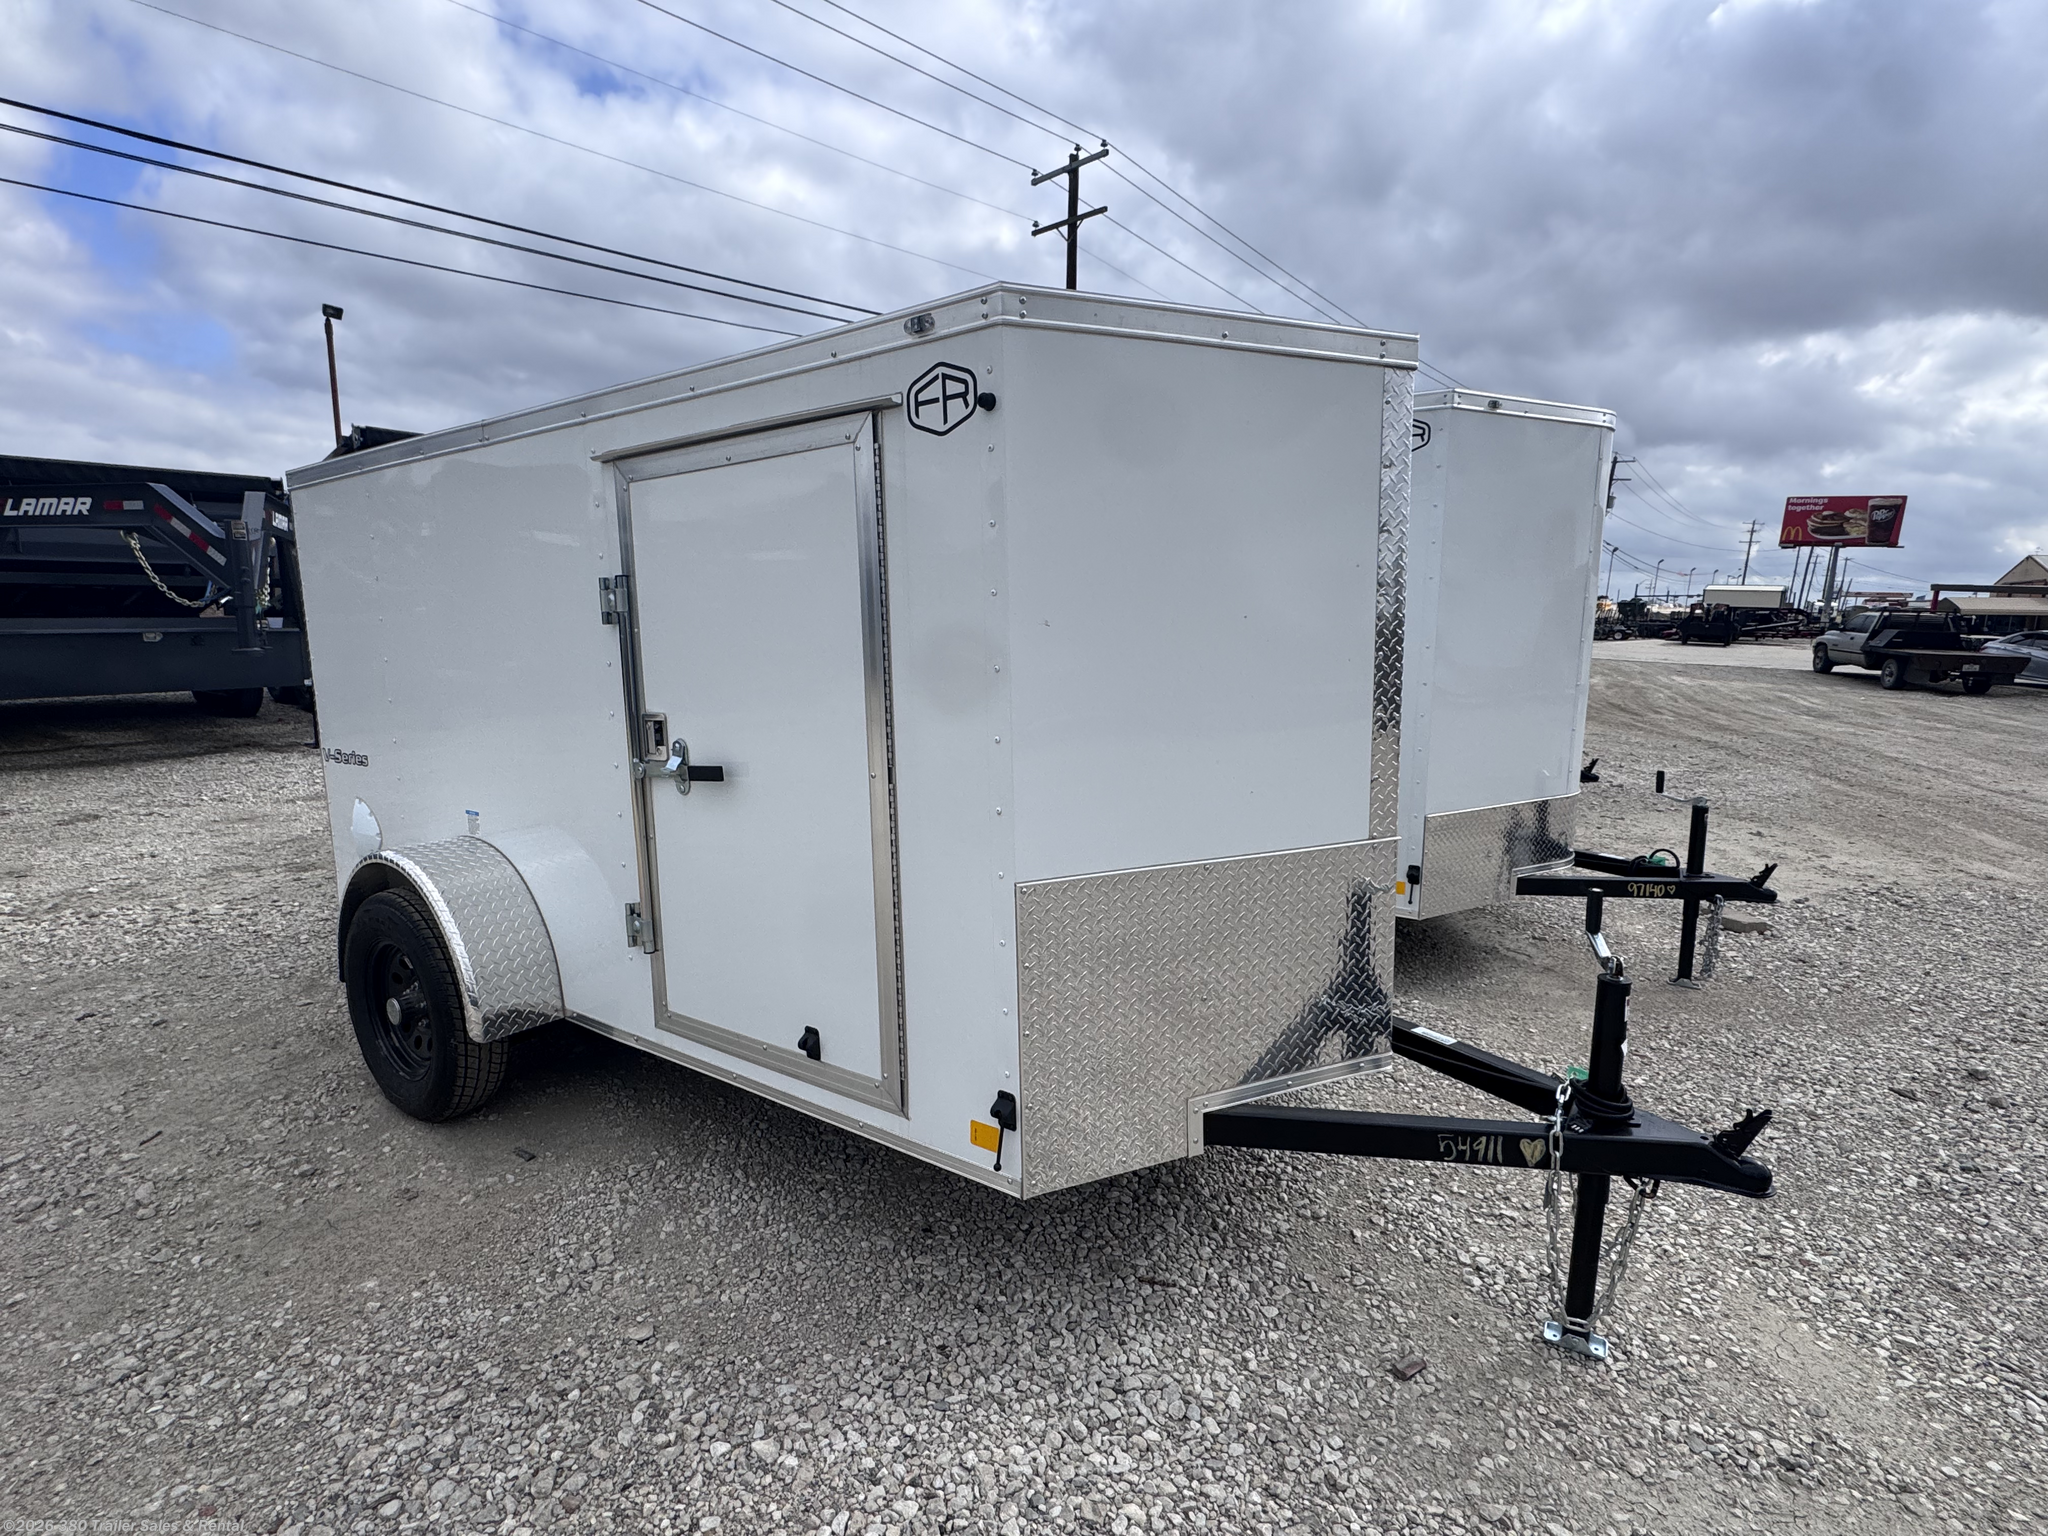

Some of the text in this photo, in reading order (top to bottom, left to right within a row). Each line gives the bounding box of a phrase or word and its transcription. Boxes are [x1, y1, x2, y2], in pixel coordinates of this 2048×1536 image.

[914, 372, 970, 426] FR
[3, 497, 93, 516] LAMAR
[1788, 504, 1824, 512] together
[1627, 882, 1666, 897] 97140
[1437, 1133, 1503, 1164] 54911
